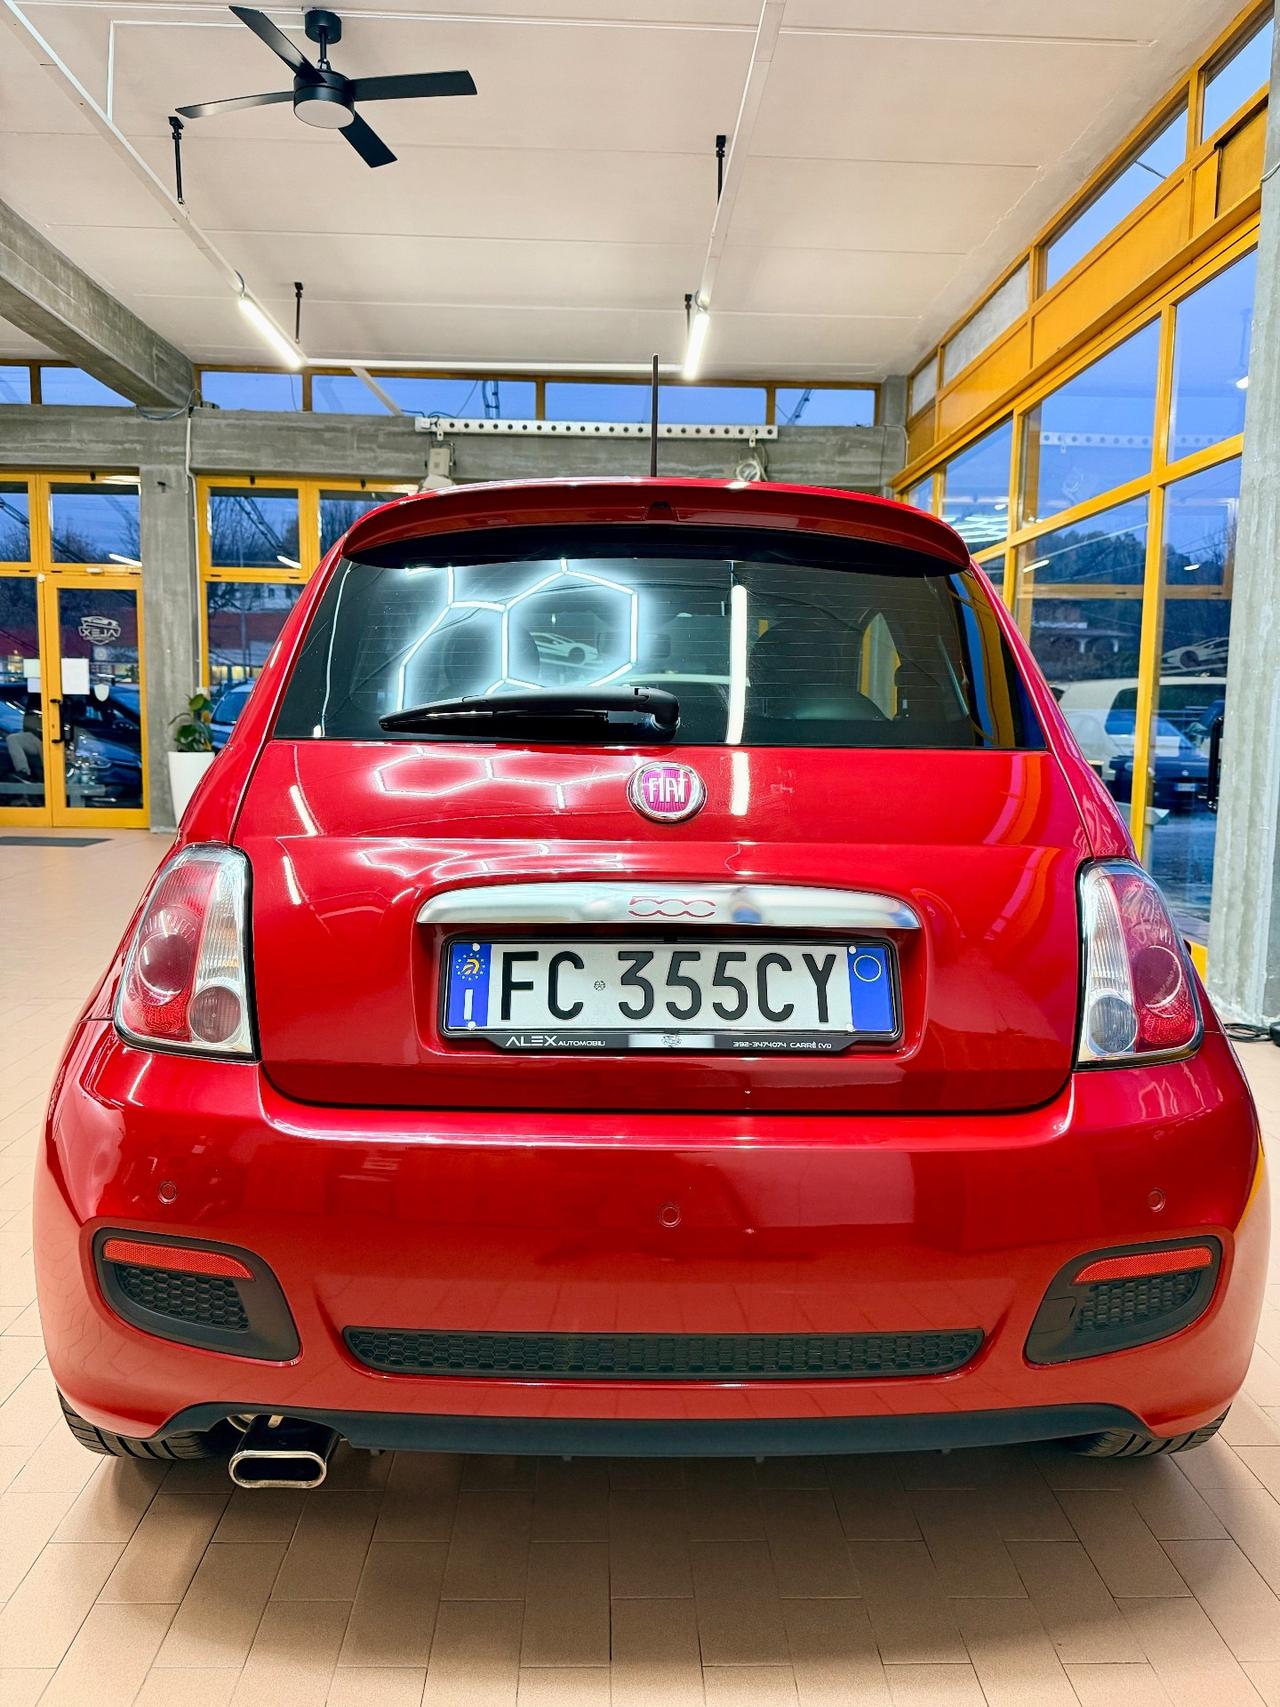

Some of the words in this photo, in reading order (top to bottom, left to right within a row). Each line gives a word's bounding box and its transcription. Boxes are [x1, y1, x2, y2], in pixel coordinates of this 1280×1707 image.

[648, 768, 688, 803] FIAT
[500, 951, 585, 1022] FC
[617, 951, 837, 1023] 355CY
[505, 1035, 557, 1047] ALEX
